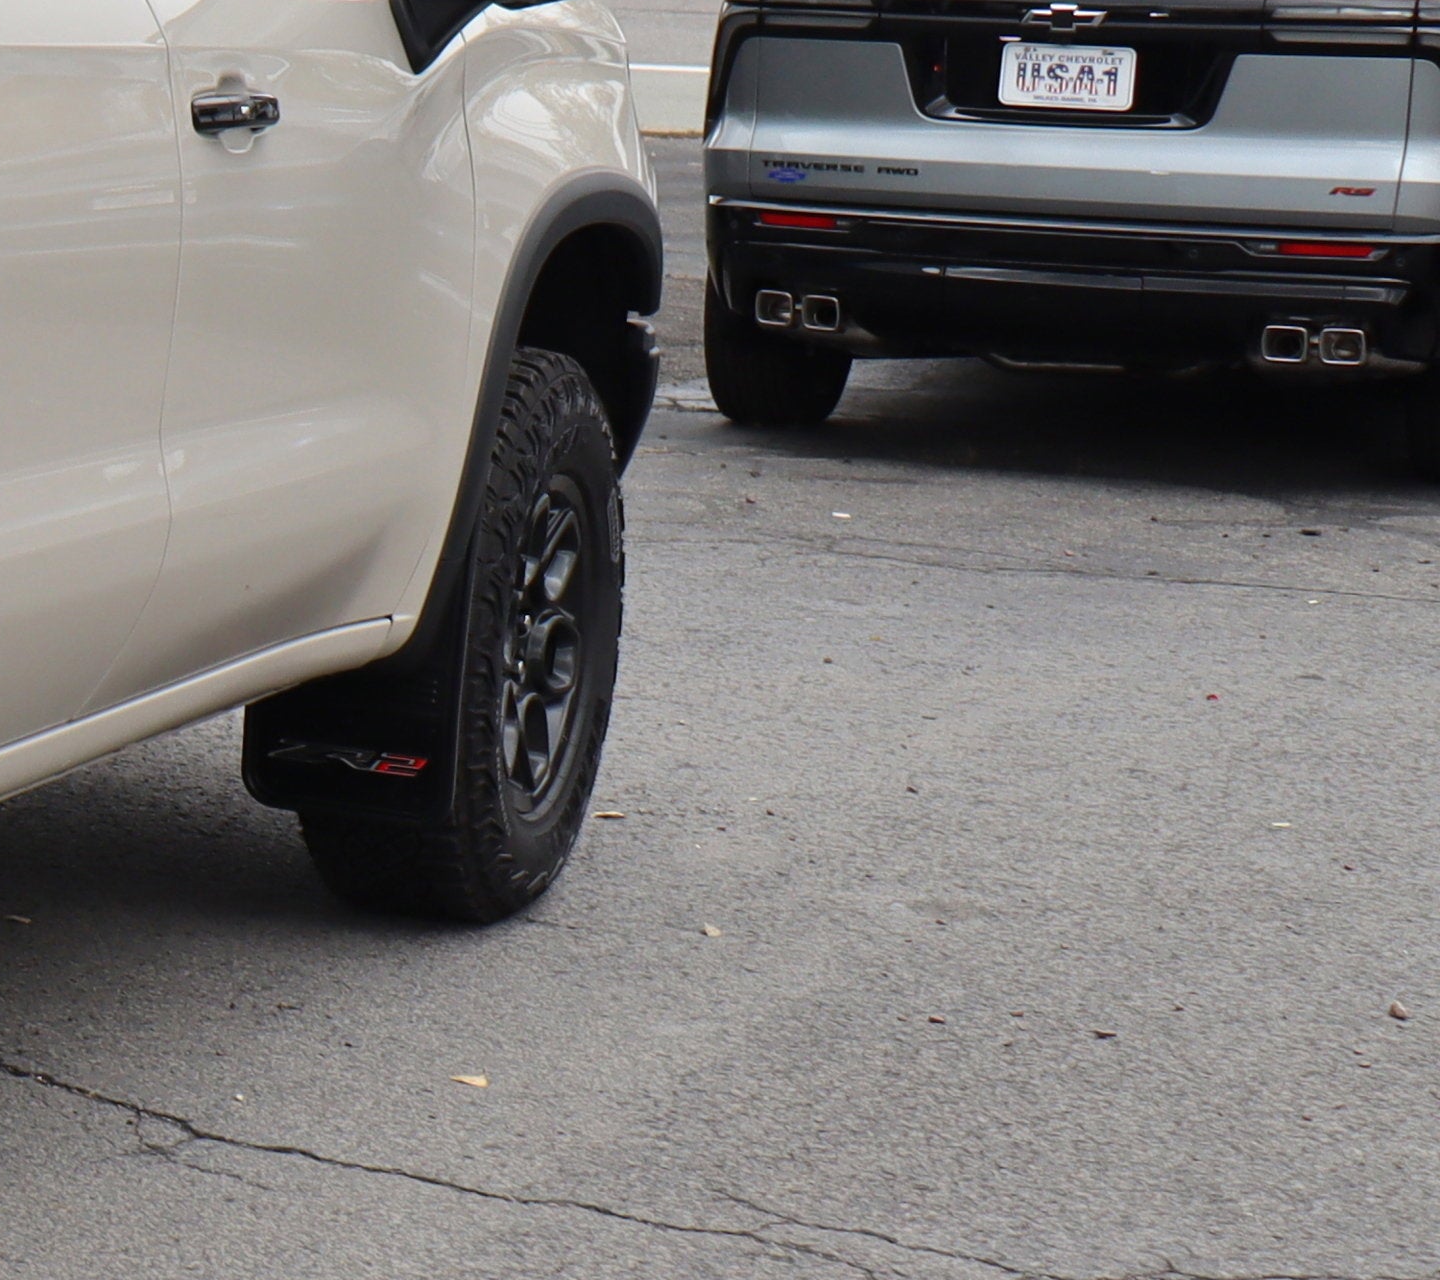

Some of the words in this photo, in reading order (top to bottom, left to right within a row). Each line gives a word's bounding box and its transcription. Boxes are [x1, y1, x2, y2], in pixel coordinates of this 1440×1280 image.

[1015, 51, 1055, 63] VALLEY
[1058, 54, 1124, 66] CHEVROLET
[761, 159, 866, 174] TRAVERSE
[877, 166, 920, 177] AWD
[1328, 186, 1377, 197] RS
